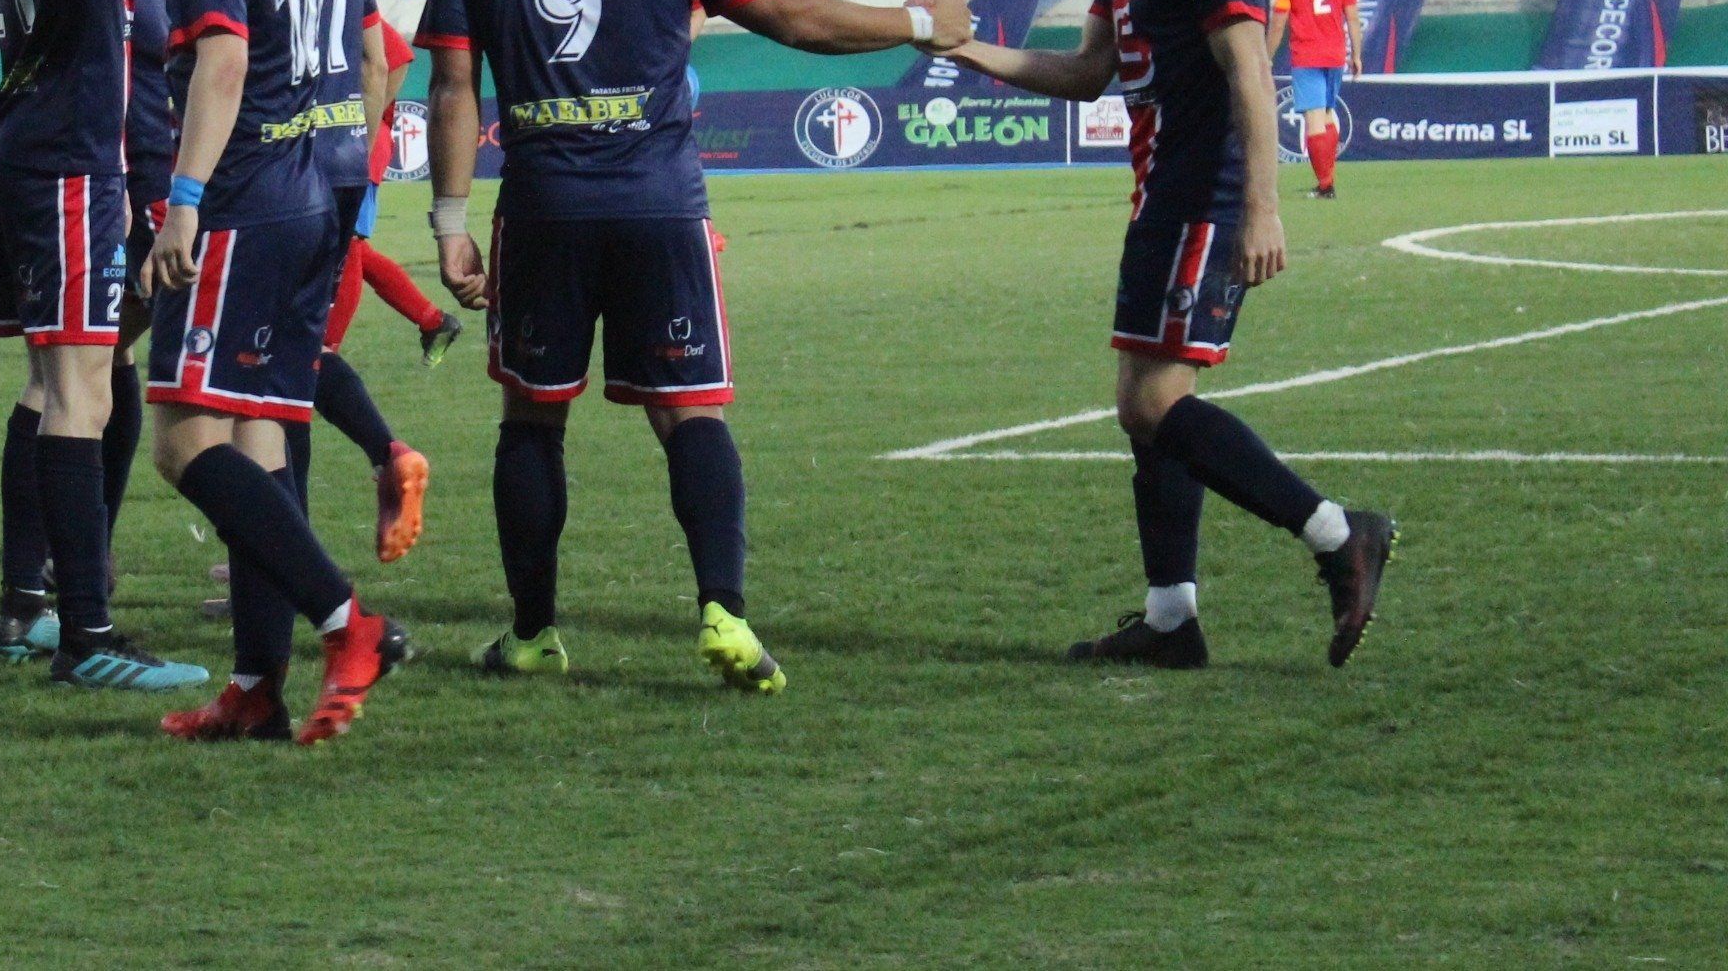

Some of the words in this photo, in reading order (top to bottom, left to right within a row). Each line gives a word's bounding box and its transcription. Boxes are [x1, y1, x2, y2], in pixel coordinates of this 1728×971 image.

[813, 88, 862, 104] LUCECOR
[897, 103, 924, 121] EL
[904, 114, 1050, 149] GALEÓN
[1369, 118, 1495, 144] Graferma
[1502, 118, 1533, 142] SL
[1608, 129, 1630, 145] SL
